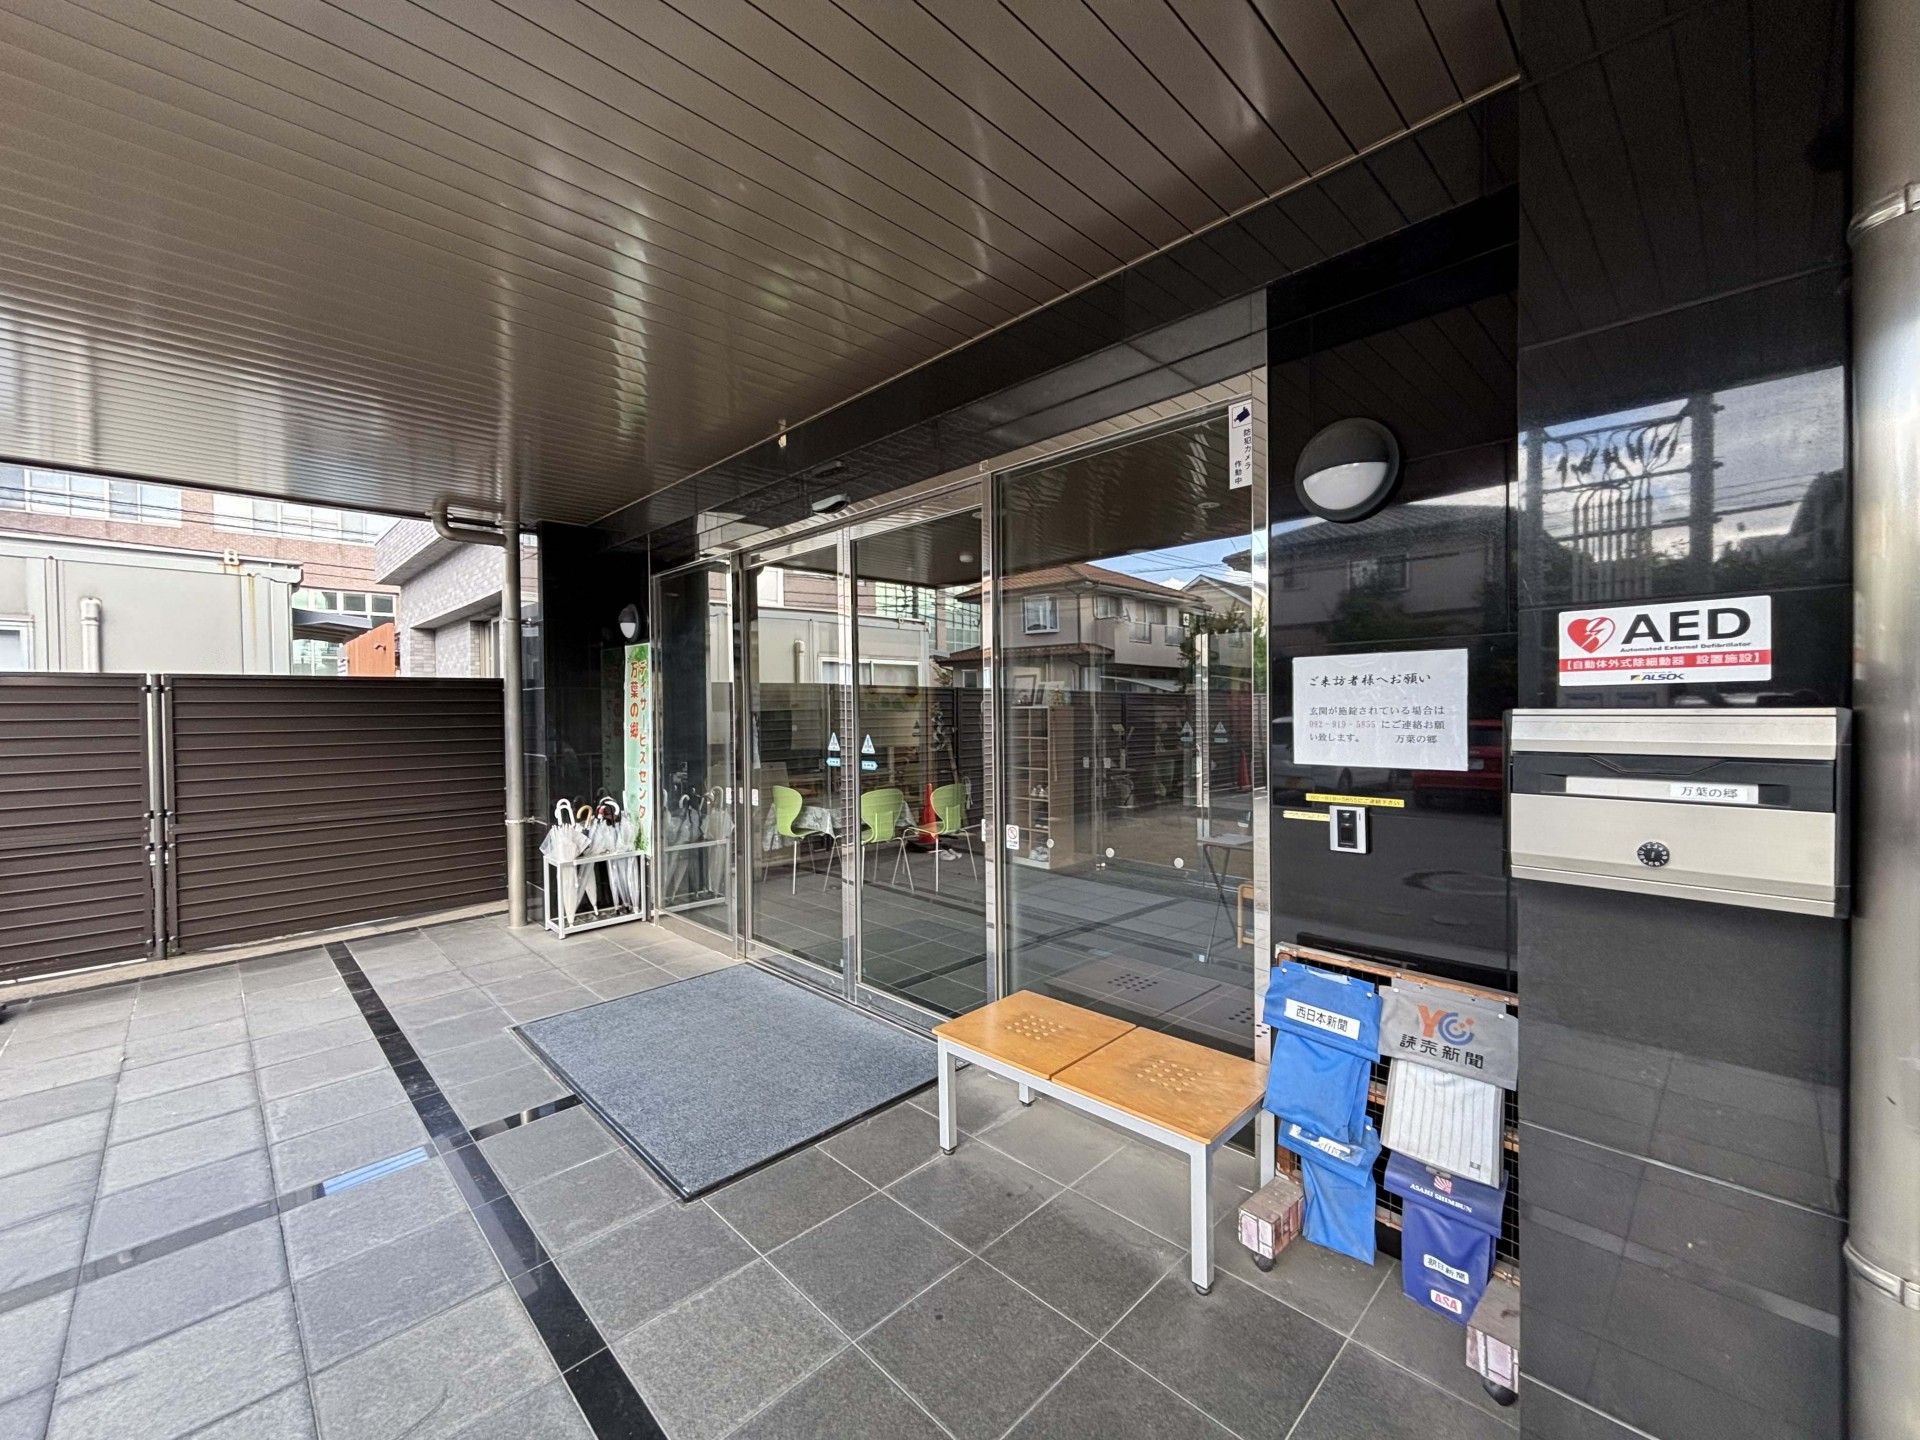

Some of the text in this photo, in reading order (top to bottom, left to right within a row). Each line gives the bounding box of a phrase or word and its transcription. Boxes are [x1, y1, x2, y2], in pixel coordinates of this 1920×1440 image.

[1243, 428, 1252, 470] 防犯カメラ
[1234, 460, 1243, 484] 作動中
[1621, 607, 1751, 645] AED
[1620, 645, 1663, 653] Automated
[1700, 641, 1752, 649] Defibrillator
[1309, 672, 1431, 687] ご来訪者様へお願い
[1642, 672, 1685, 681] ALSOK
[629, 661, 639, 739] 万葉の郷
[1309, 705, 1446, 716] 玄関が施錠されている場合は
[1394, 734, 1438, 744] 万葉の郷
[1680, 786, 1738, 799] 万葉の郷
[1295, 1005, 1348, 1033] 西日本新聞
[1400, 1033, 1484, 1070] 読売新聞
[1410, 1183, 1473, 1213] ASAHI SHIMBUN
[1427, 1257, 1466, 1281] 朝日新聞
[1435, 1293, 1459, 1312] ASA
